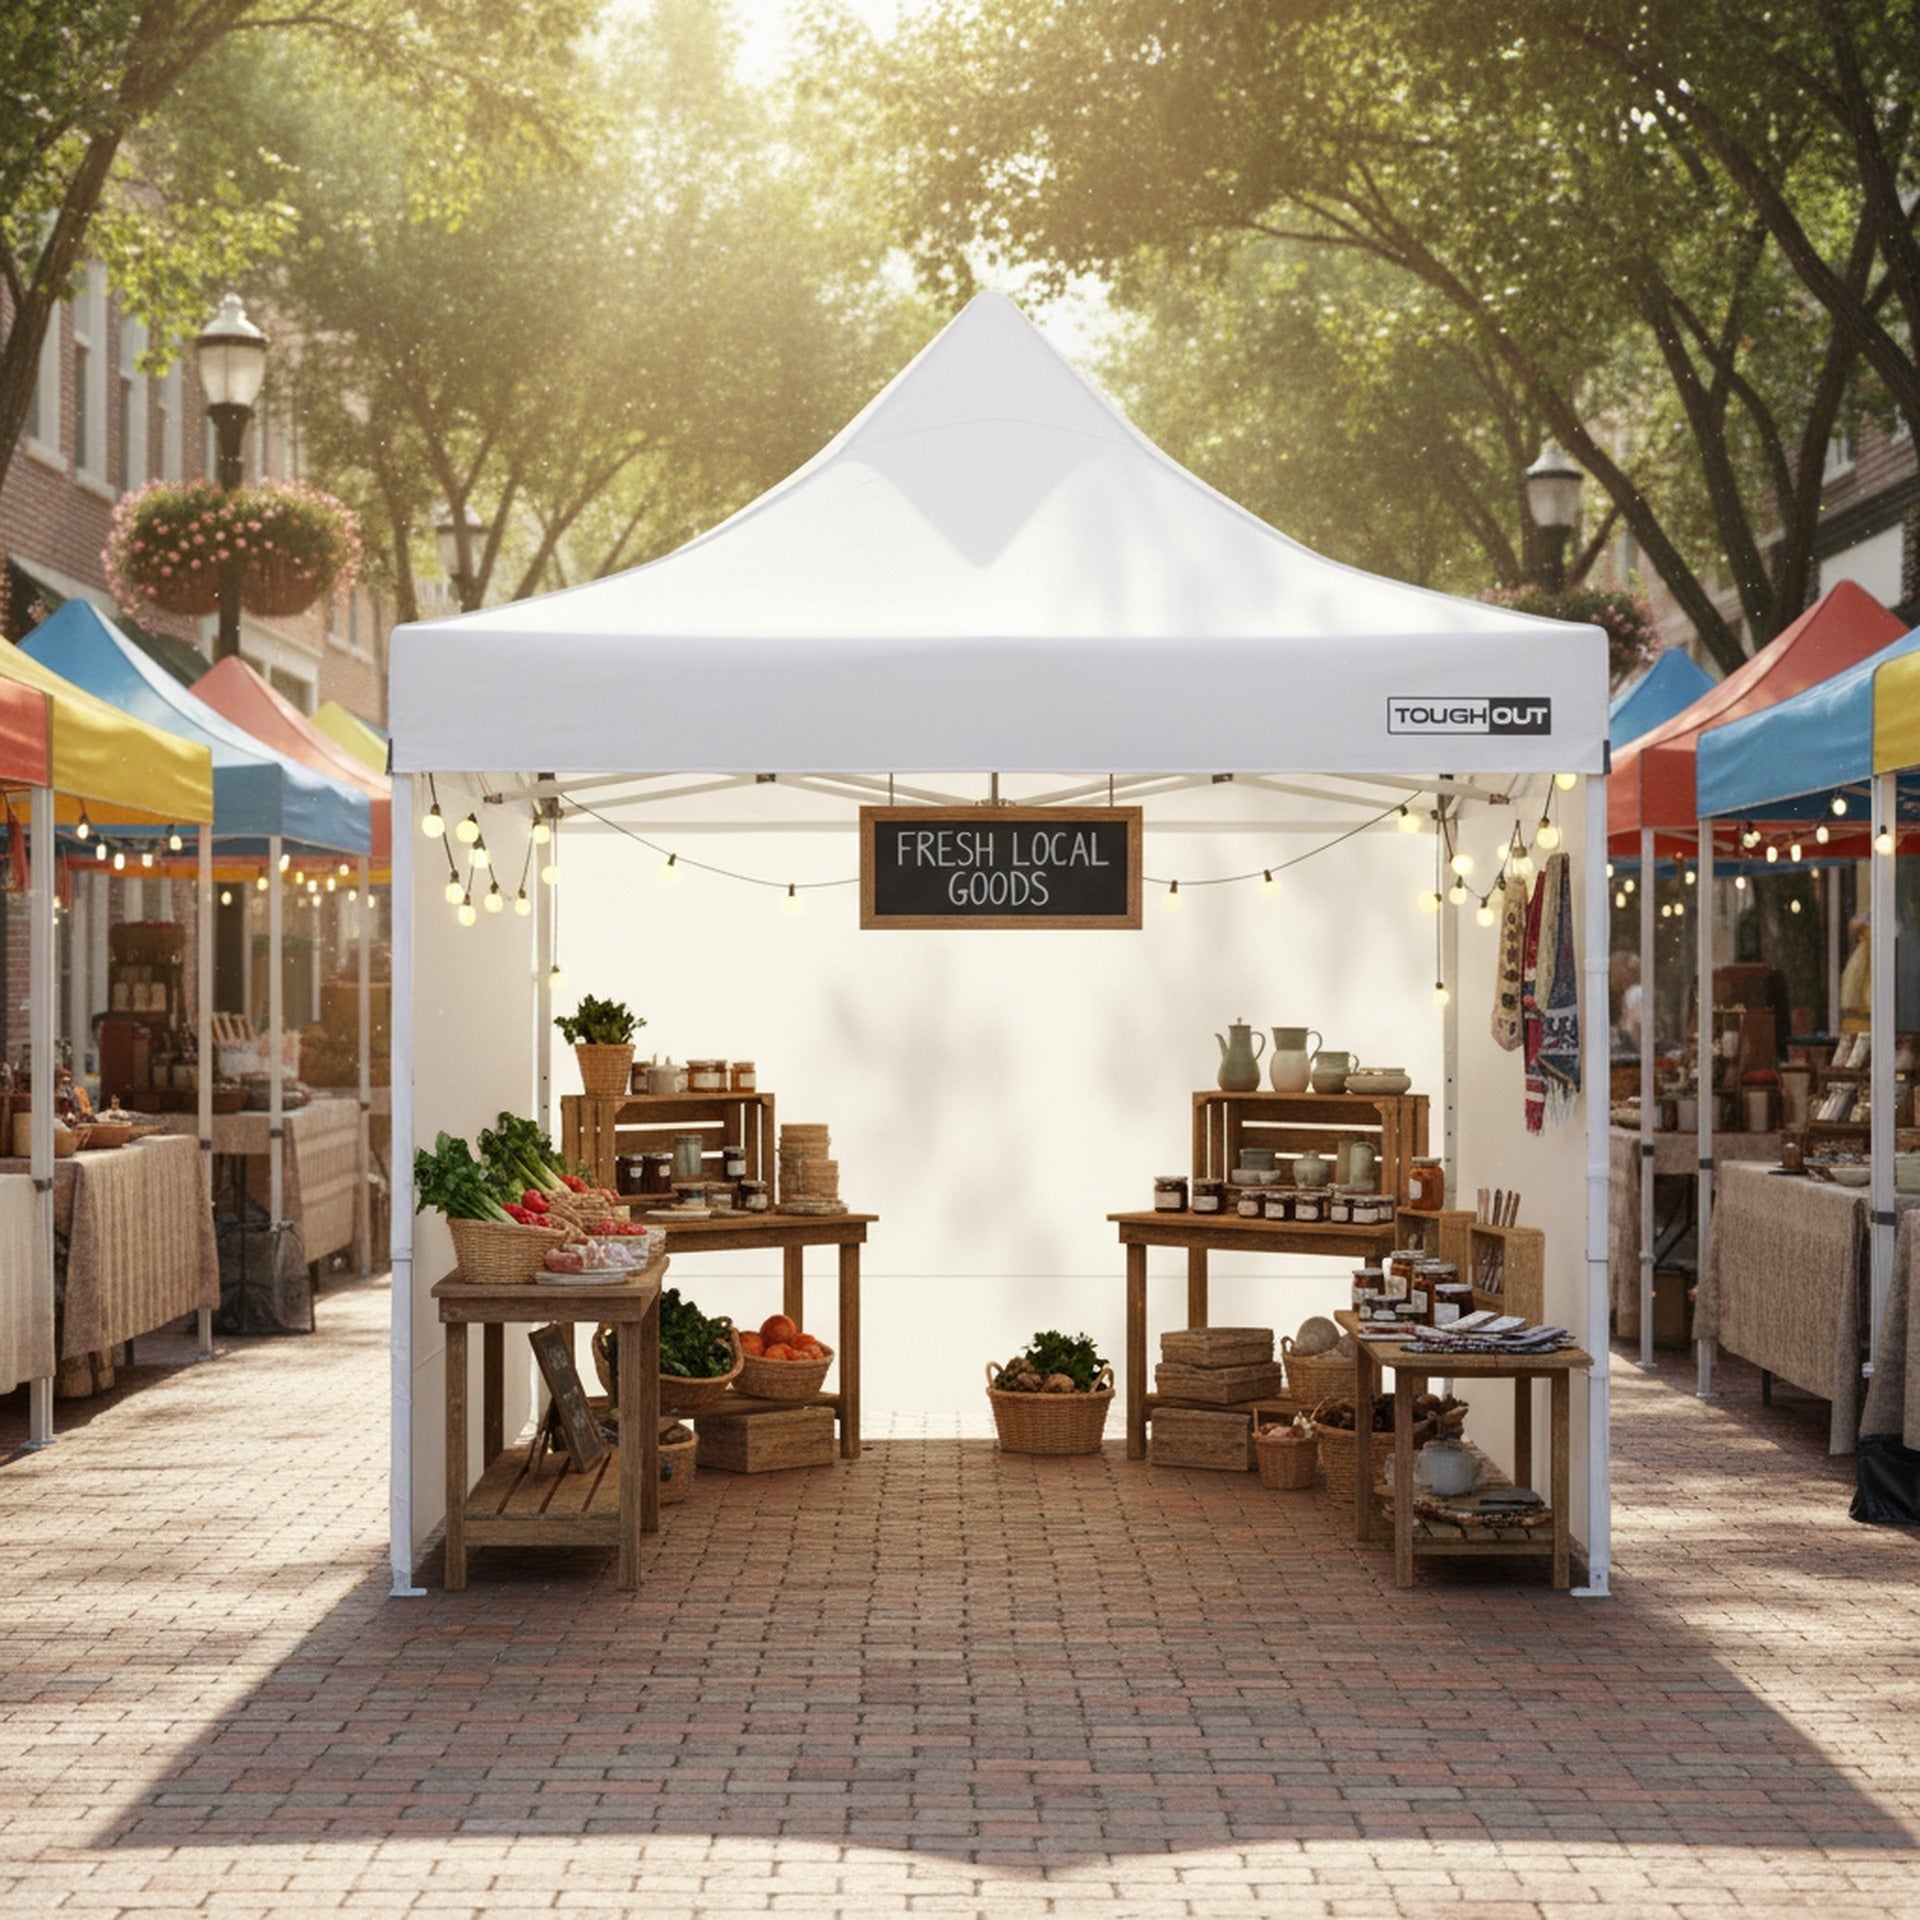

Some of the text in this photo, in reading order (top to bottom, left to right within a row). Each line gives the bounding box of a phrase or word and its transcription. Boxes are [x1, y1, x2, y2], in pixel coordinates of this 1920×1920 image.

[897, 831, 1110, 867] FRESH LOCAL
[948, 871, 1049, 906] GOODS
